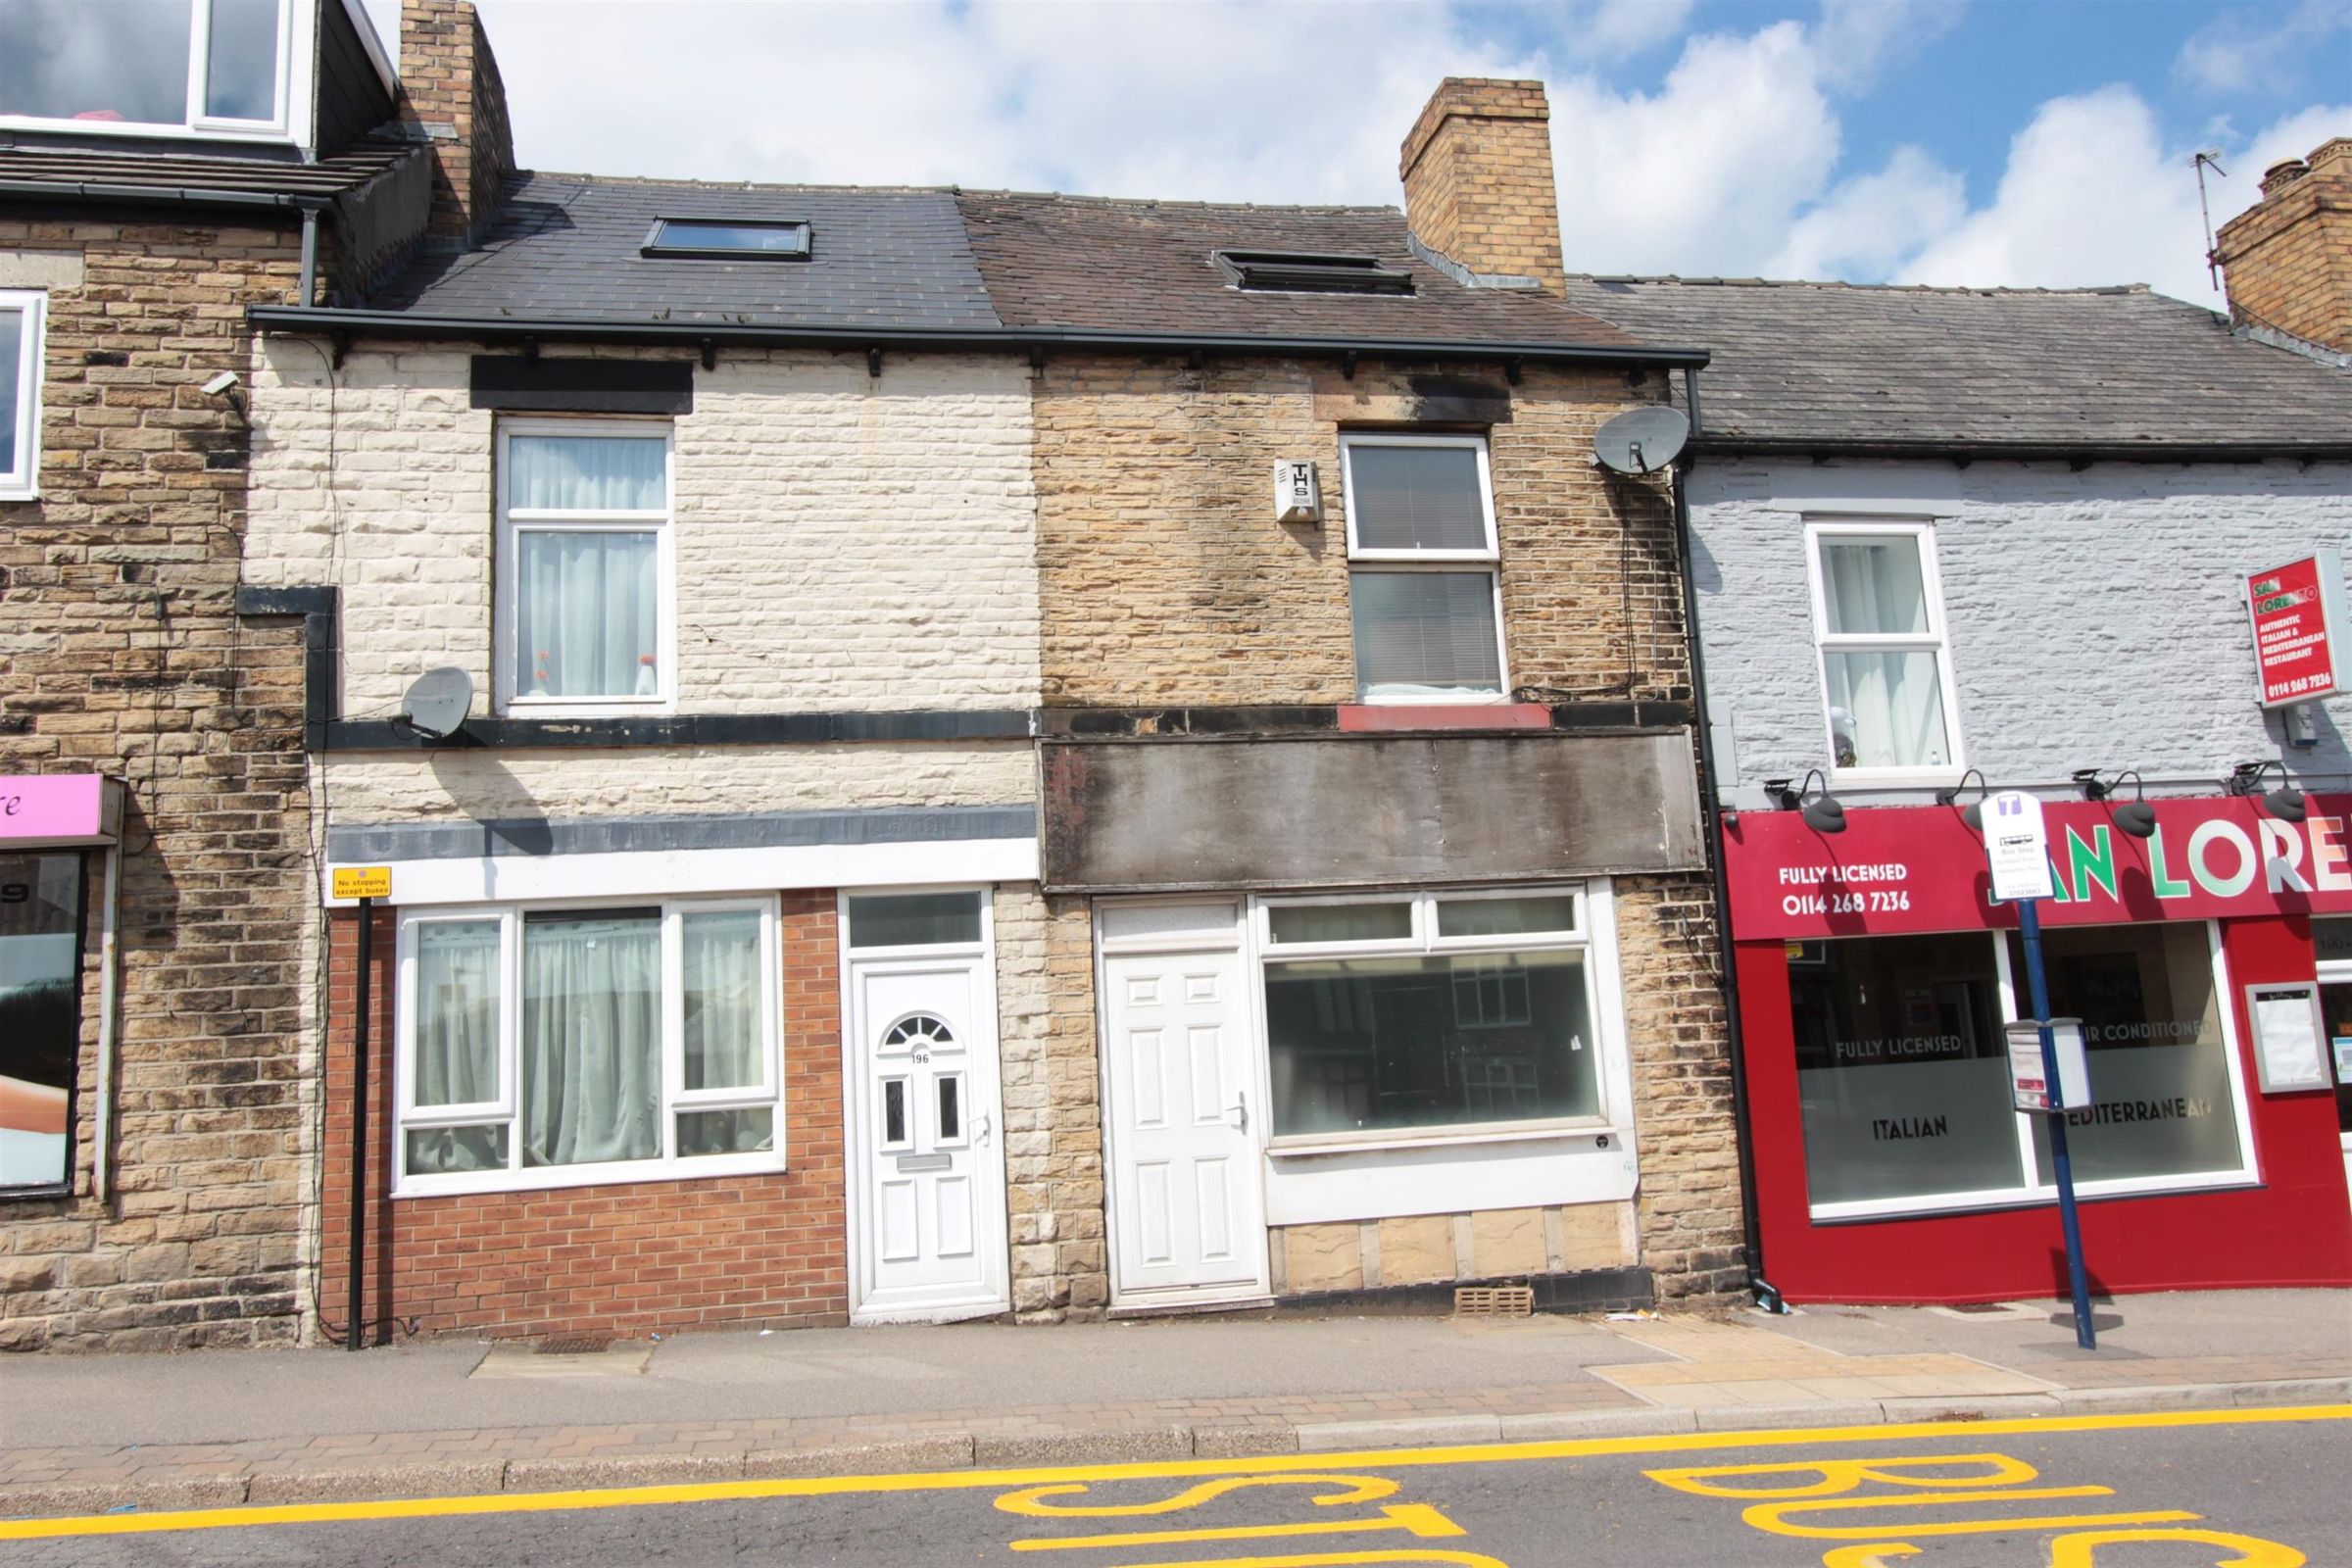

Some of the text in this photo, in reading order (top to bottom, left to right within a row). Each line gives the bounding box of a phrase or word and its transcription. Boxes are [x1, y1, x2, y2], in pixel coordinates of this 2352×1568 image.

[1292, 464, 1308, 496] THS
[2252, 575, 2281, 598] SAN
[2259, 614, 2301, 633] AUTHENTIC
[2261, 629, 2291, 644] ITALIAN
[2262, 631, 2326, 656] MEDITERRANEAN
[2264, 648, 2313, 666] RESTAURANT
[2268, 672, 2331, 698] 0114 268 7236
[353, 878, 386, 887] stopping
[1779, 863, 1907, 885] FULLY LICENSED
[1782, 892, 1910, 916] 0114 268 7236
[1836, 1020, 2212, 1059] FULLY LICENSED IR CONDITIONED
[911, 1054, 929, 1064] 196
[1873, 1097, 2212, 1141] ITALIAN EDITERRANEAN
